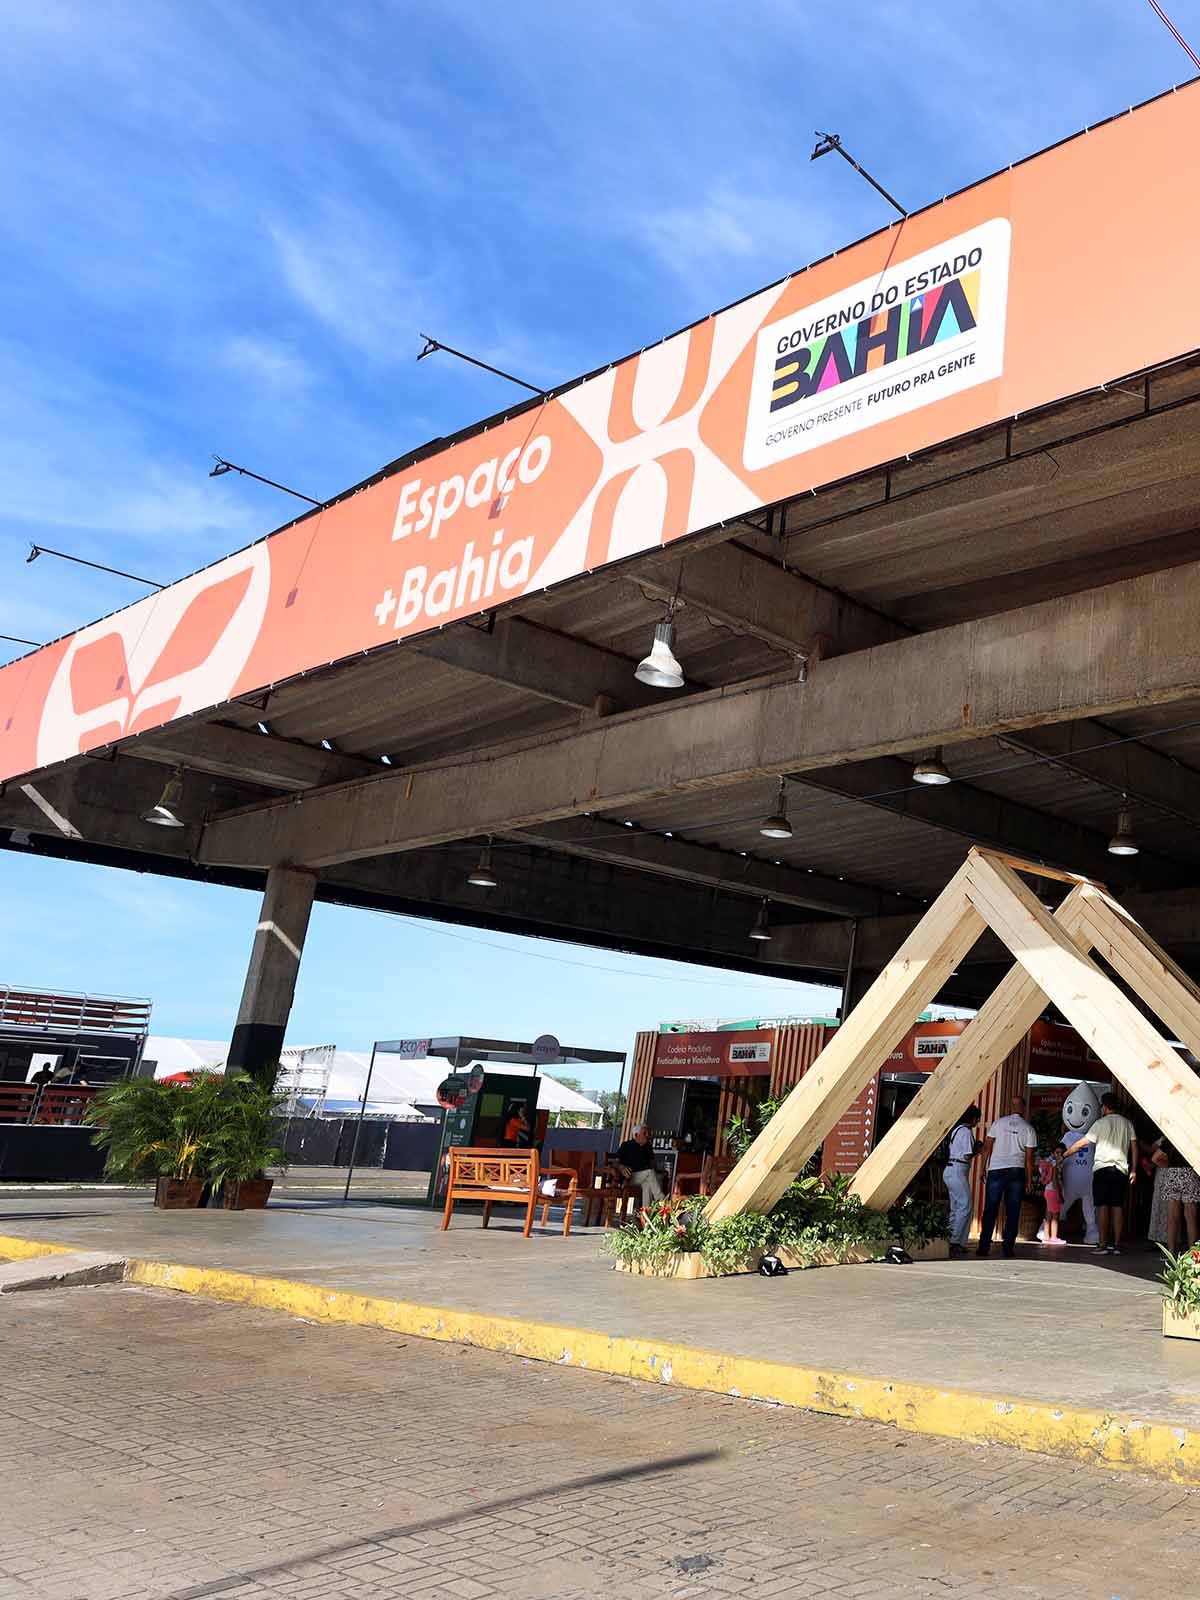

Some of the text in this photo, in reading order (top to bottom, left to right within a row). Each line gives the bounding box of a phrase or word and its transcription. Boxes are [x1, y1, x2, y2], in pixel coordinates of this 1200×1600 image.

[769, 277, 977, 414] BAHIA
[776, 247, 983, 354] GOVERNO DO ESTADO
[765, 353, 977, 447] GOVERNO PRESENTE FUTURO PRA GENTE
[391, 434, 552, 542] Espaço
